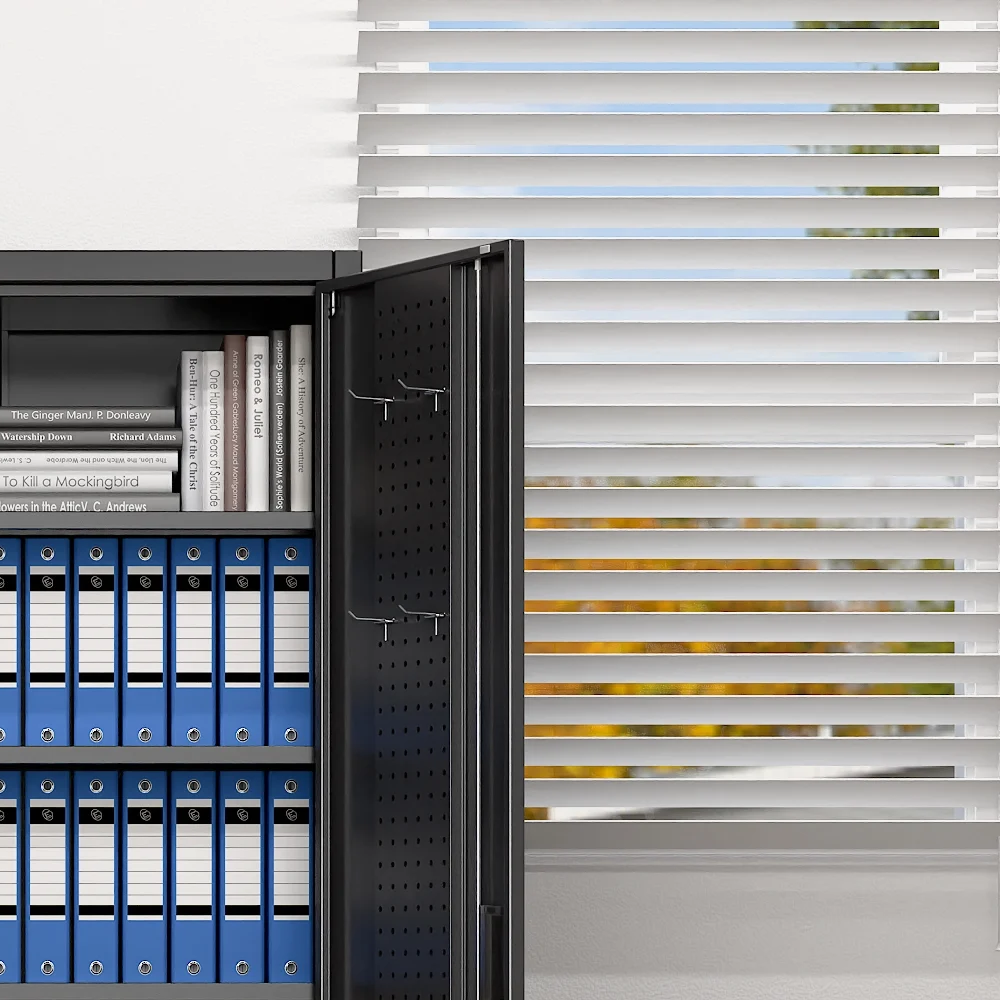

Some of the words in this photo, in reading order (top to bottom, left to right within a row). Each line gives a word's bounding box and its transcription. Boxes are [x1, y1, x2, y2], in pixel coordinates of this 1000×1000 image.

[189, 358, 198, 401] Ben-Hur:
[210, 370, 220, 389] One
[254, 354, 263, 394] Romeo
[210, 392, 220, 430] Hundred
[296, 387, 305, 416] History
[11, 410, 28, 420] The
[32, 410, 64, 422] Ginger
[96, 410, 104, 420] P.
[106, 410, 151, 422] Donleavy
[189, 413, 198, 432] Tale
[254, 409, 263, 438] Juliet
[276, 402, 284, 430] verden)
[298, 419, 305, 429] of
[1, 433, 45, 443] Watership
[189, 434, 198, 443] of
[210, 433, 220, 457] Years
[276, 433, 284, 456] (Sofies
[189, 445, 198, 459] the
[189, 462, 198, 490] Christ
[210, 460, 220, 470] of
[3, 476, 17, 487] To
[22, 476, 38, 487] Kill
[42, 478, 51, 487] a
[55, 476, 139, 490] Mockingbird
[210, 471, 220, 507] Solitude
[231, 466, 239, 510] Montgomery
[31, 501, 40, 512] in
[42, 501, 57, 512] the
[106, 501, 147, 512] Andrews
[276, 480, 284, 510] Sophie's
